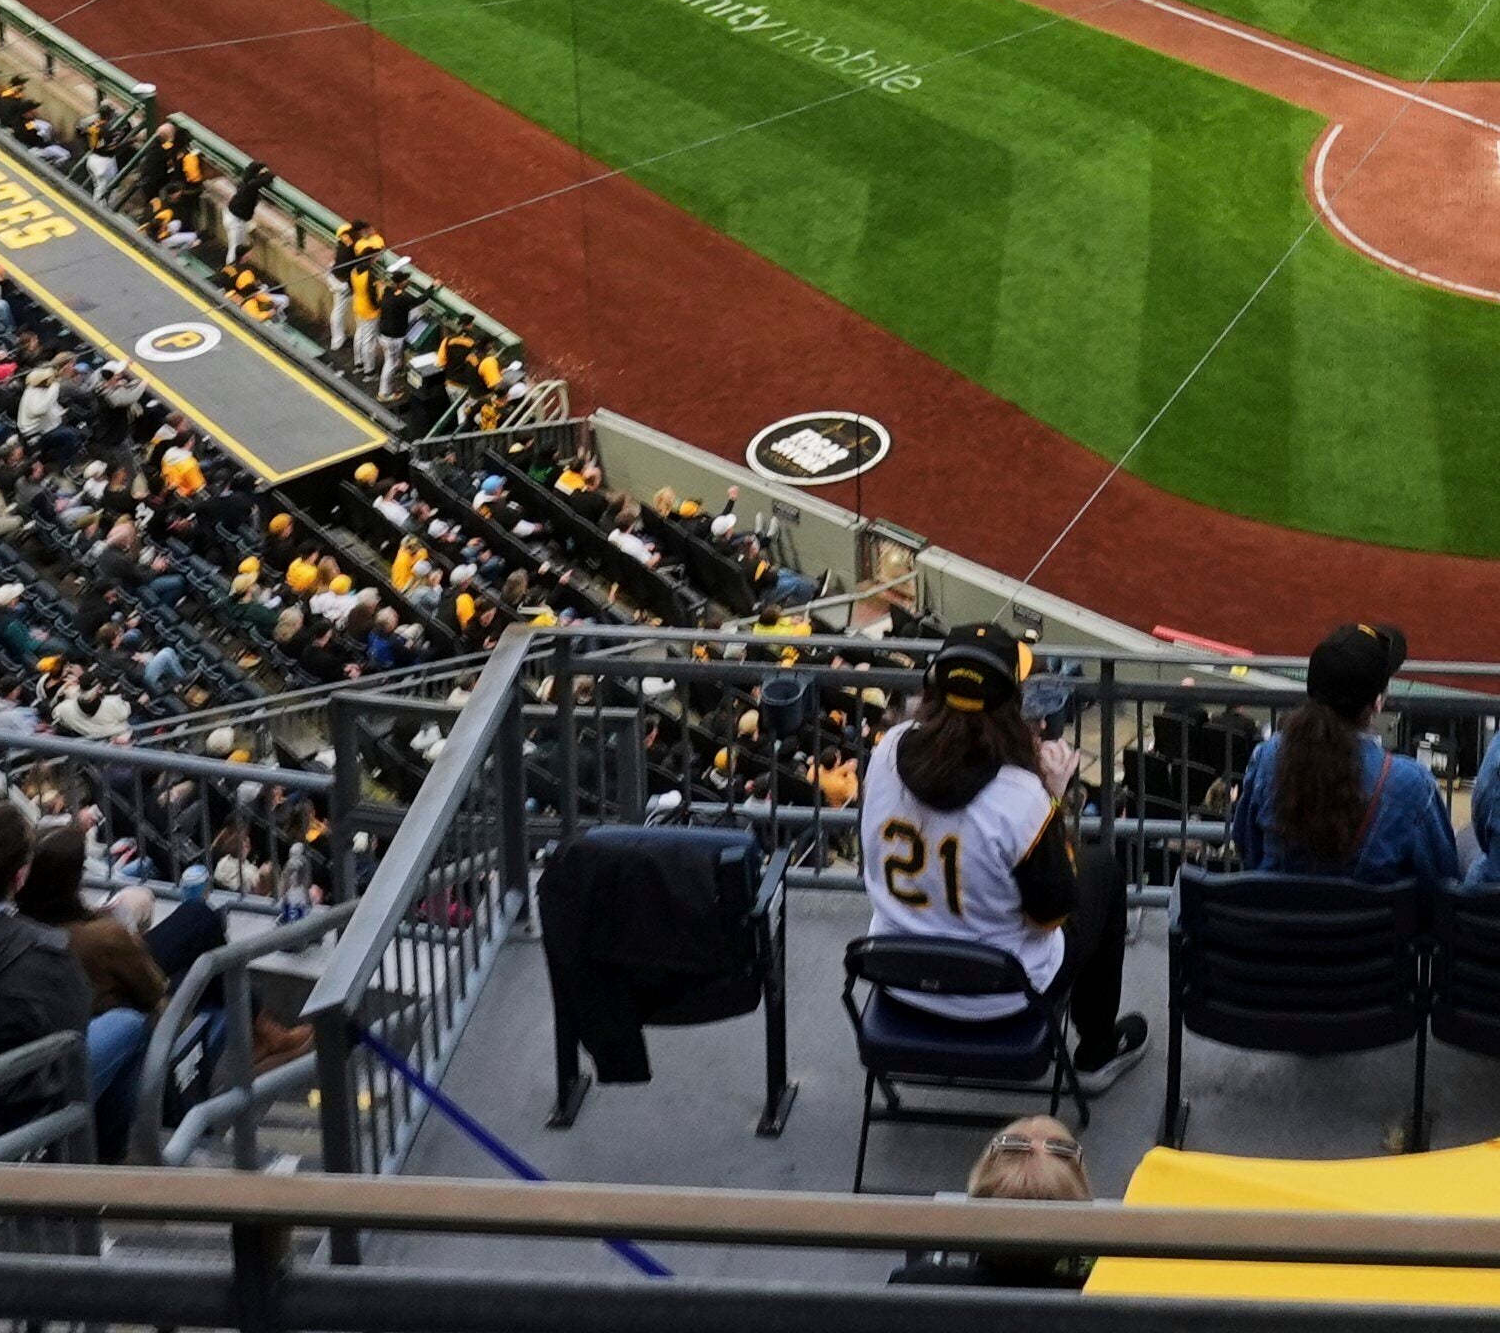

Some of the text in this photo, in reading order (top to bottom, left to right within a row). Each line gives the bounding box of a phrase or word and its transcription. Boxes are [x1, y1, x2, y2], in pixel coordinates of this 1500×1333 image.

[767, 29, 923, 93] mobile
[152, 330, 206, 352] P
[881, 817, 963, 917] 21
